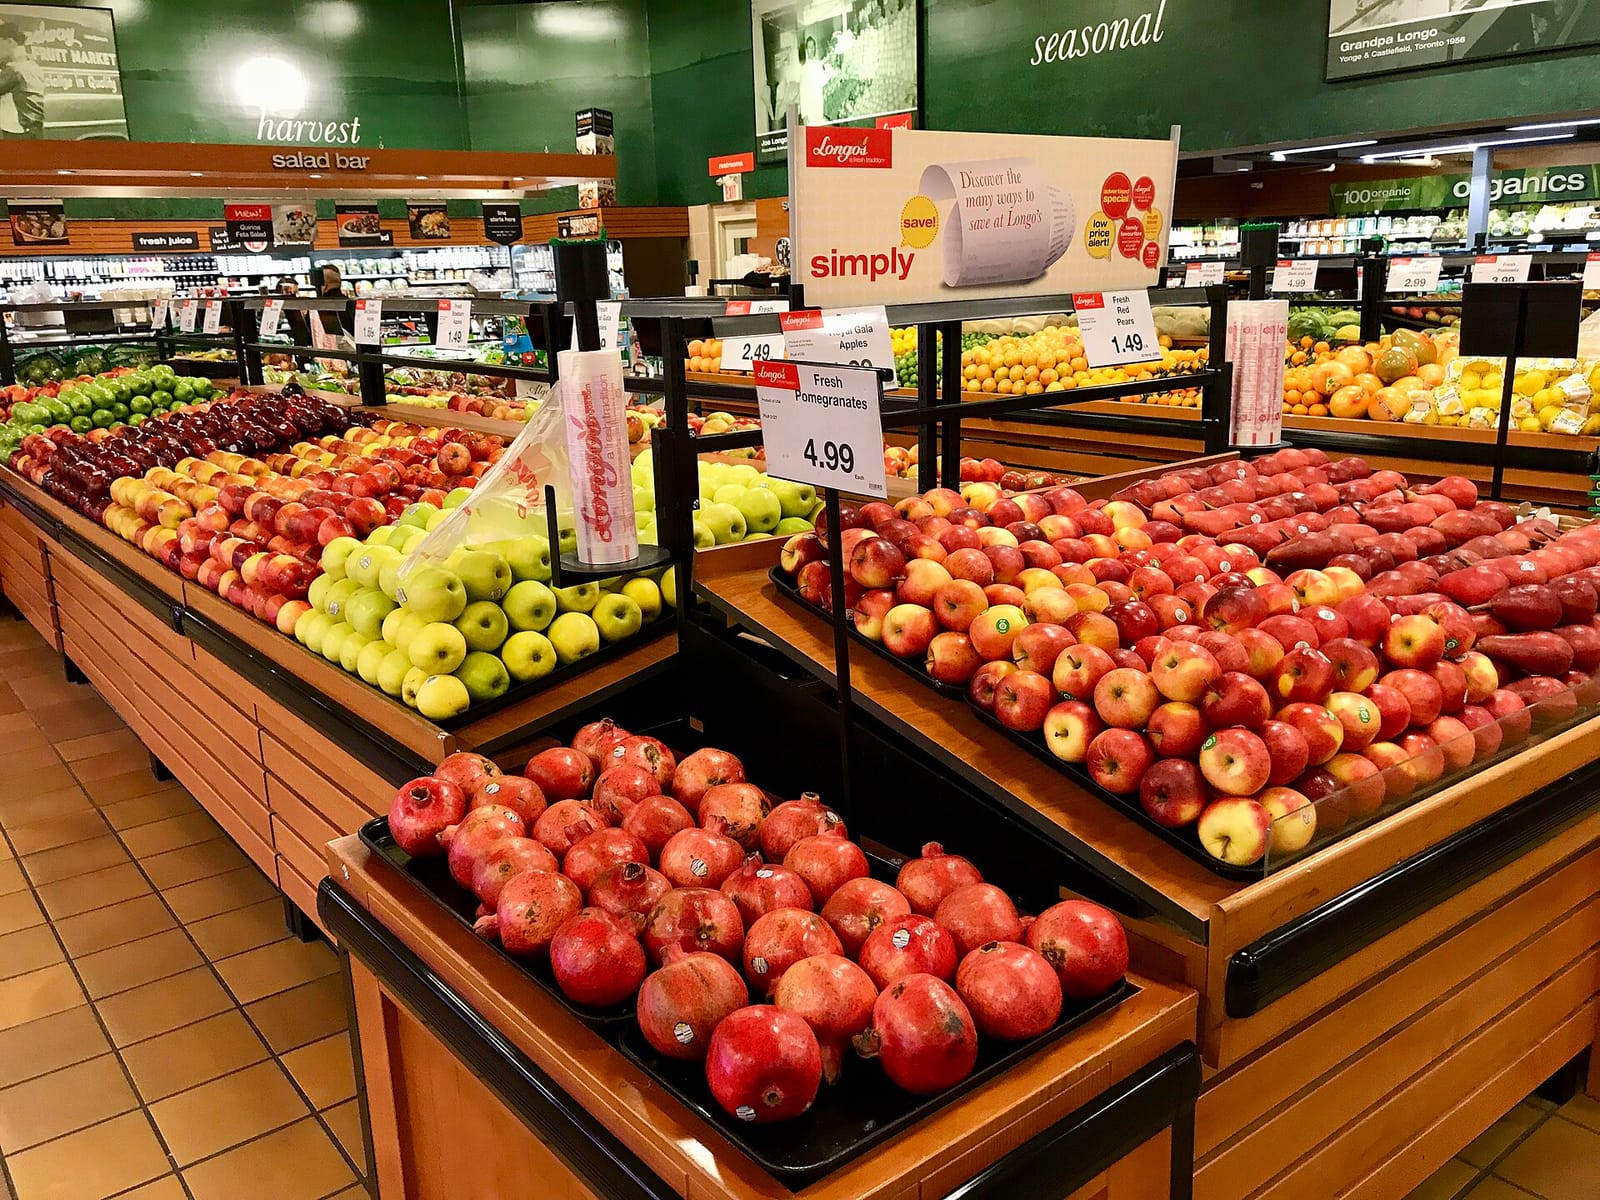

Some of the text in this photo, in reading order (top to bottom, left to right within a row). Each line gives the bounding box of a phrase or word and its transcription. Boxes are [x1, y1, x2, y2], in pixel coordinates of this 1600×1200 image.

[1030, 0, 1166, 66] seasonal
[1340, 28, 1438, 52] Grandpa Longo
[70, 49, 117, 67] MARKET
[1340, 54, 1362, 62] Yonge
[1414, 40, 1445, 50] Toronto
[256, 106, 361, 144] harvest
[272, 151, 371, 169] salad bar
[960, 167, 1022, 189] Discover the
[1453, 171, 1585, 201] oganics
[965, 187, 1035, 211] many ways to
[1103, 195, 1130, 204] special
[1343, 186, 1411, 204] 100 organic
[903, 216, 936, 228] save!
[968, 209, 1043, 231] save at Longo's
[1093, 219, 1108, 228] low
[139, 236, 193, 246] fresh juice
[1088, 238, 1110, 247] alert!
[1089, 228, 1110, 239] price
[810, 246, 915, 282] simply
[1287, 279, 1306, 288] 4.99
[1404, 278, 1427, 287] 2.99
[1112, 295, 1131, 304] Fresh
[758, 305, 774, 313] Fresh
[1116, 306, 1130, 314] Red
[854, 324, 874, 334] Gala
[1116, 318, 1135, 326] Pears
[448, 330, 462, 344] 1.49
[839, 339, 869, 351] Apples
[1111, 333, 1143, 354] 1.49
[742, 343, 770, 361] 2.49
[757, 365, 786, 383] Longo's
[813, 373, 844, 389] Fresh
[794, 389, 868, 410] Pomegranates
[803, 438, 855, 474] 4.99
